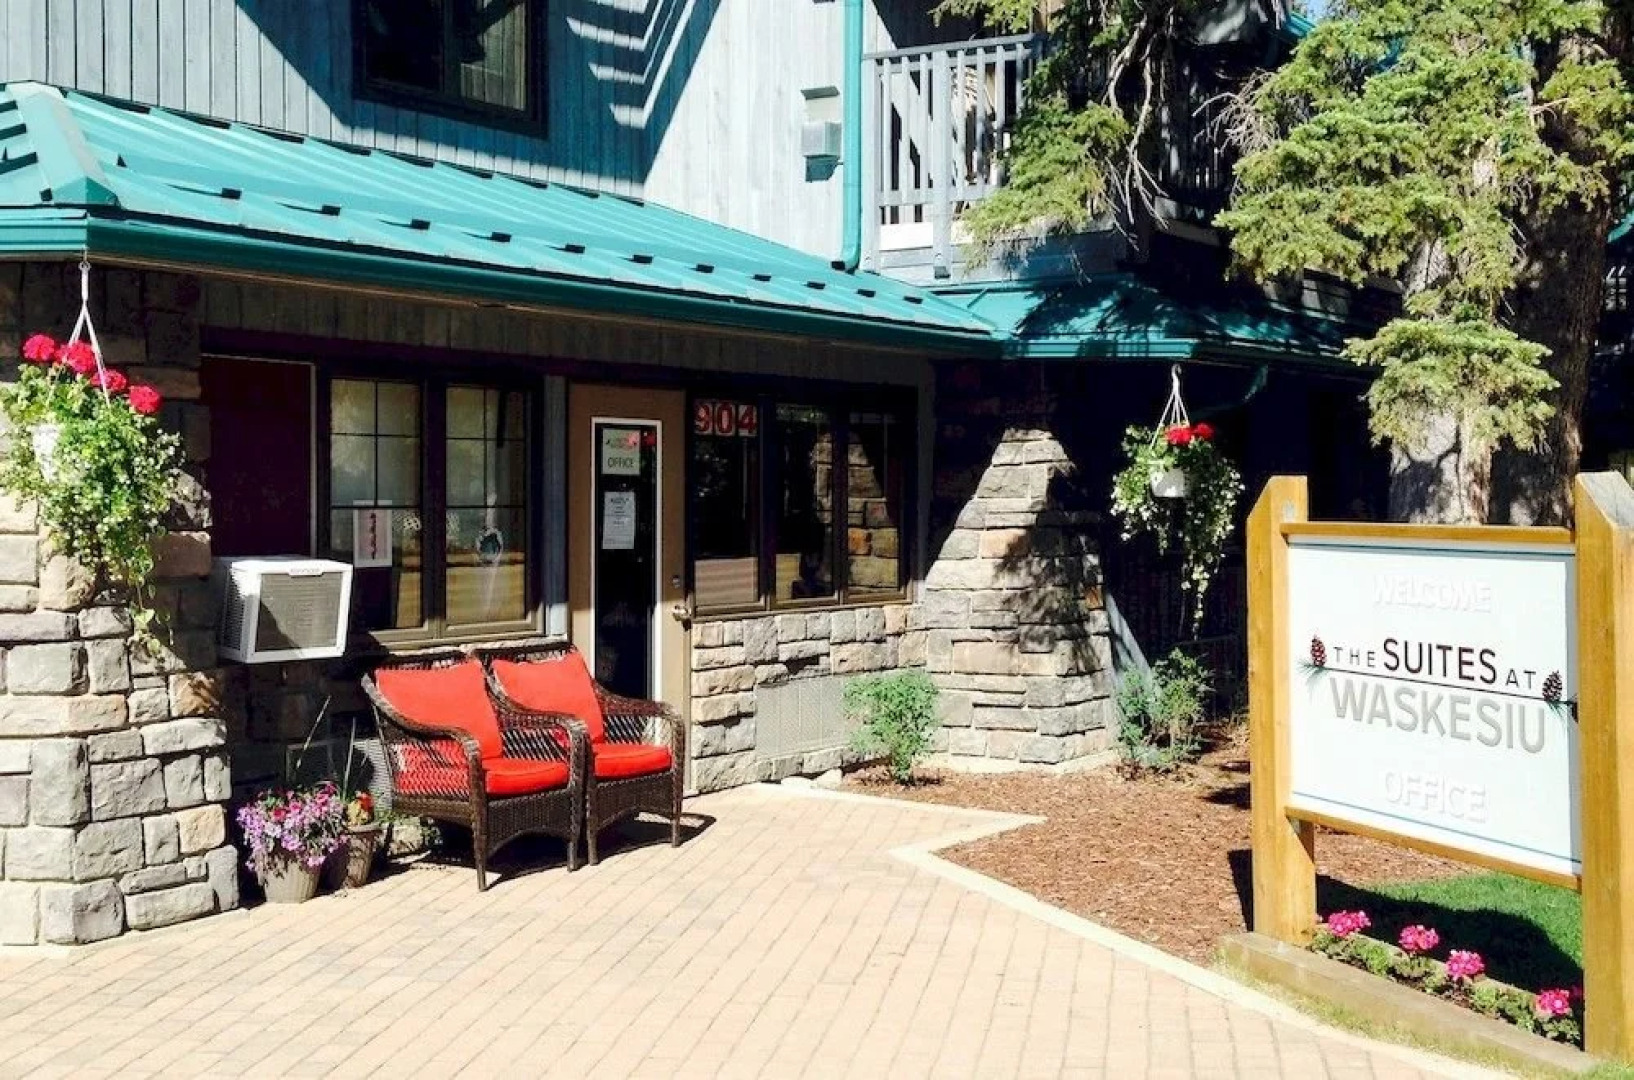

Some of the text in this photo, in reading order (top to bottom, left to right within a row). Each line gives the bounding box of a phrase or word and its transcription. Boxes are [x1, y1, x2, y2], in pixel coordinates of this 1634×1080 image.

[694, 403, 756, 434] 904
[607, 457, 635, 468] OFFICE
[1373, 574, 1492, 613] WELCOME
[1333, 638, 1537, 690] THE SUITES AT
[1329, 677, 1546, 754] WASKESIU
[1384, 771, 1487, 824] OFFICE
